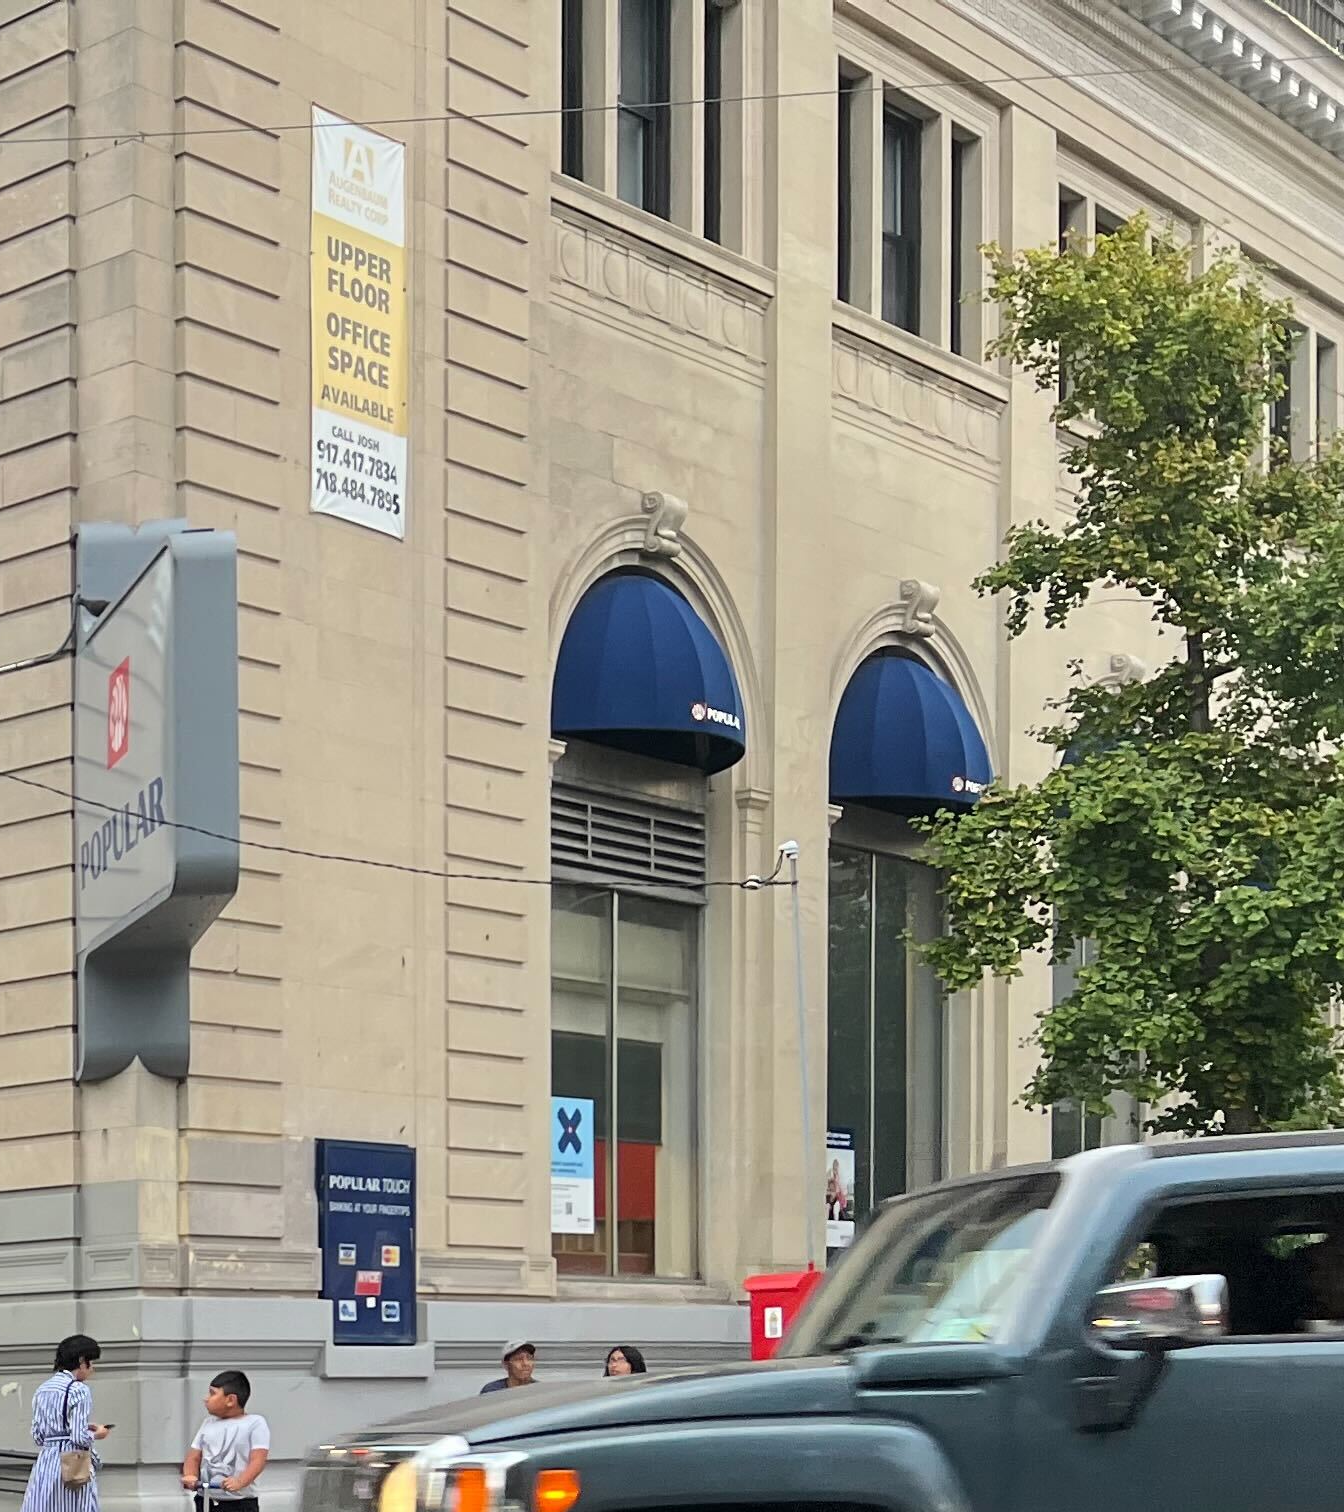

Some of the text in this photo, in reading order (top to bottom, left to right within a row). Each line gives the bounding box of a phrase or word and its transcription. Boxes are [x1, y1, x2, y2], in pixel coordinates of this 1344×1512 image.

[327, 236, 391, 284] UPPER
[327, 267, 390, 314] FLOOR
[326, 312, 390, 357] OFFICE
[328, 346, 389, 389] SPACE
[321, 384, 395, 424] AVAILABLE
[331, 425, 380, 452] CALL JOSH
[317, 439, 398, 485] 917.417.7834
[316, 468, 401, 515] 718.484.7895
[81, 776, 166, 890] POPULAR
[329, 1175, 411, 1194] POPULAR TOUCH
